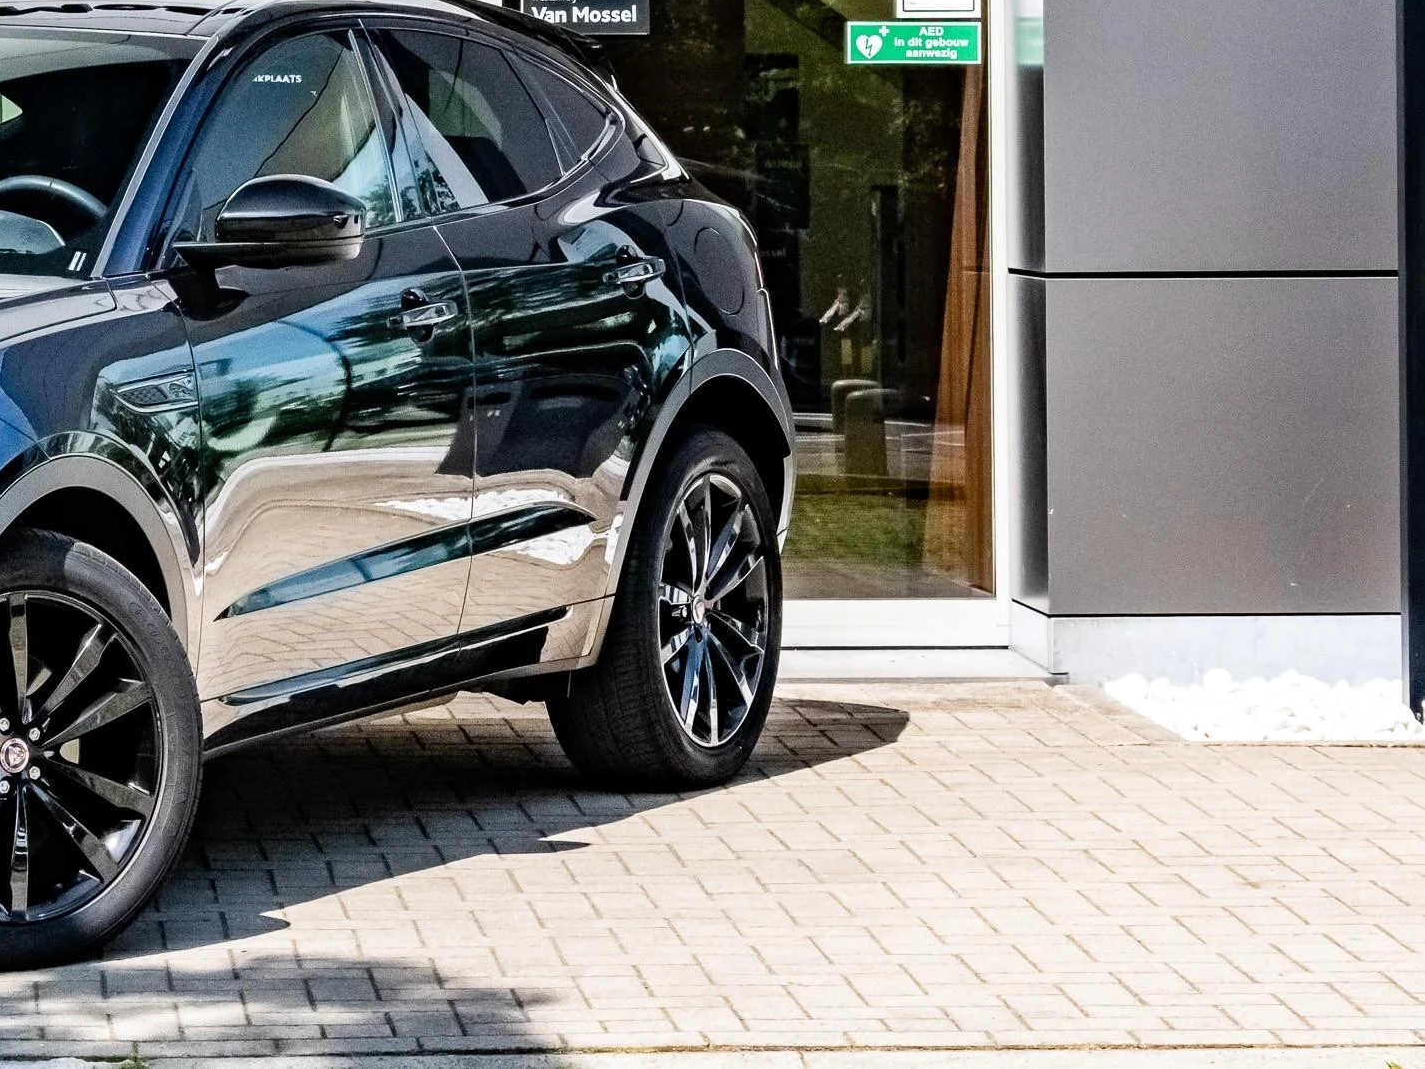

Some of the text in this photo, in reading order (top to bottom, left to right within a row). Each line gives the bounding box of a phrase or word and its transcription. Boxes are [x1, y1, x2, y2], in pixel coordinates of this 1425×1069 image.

[531, 4, 637, 24] Van Mossel
[918, 26, 945, 37] AED
[907, 36, 923, 47] dit
[925, 36, 970, 50] gebouw
[905, 48, 958, 60] aanwezig
